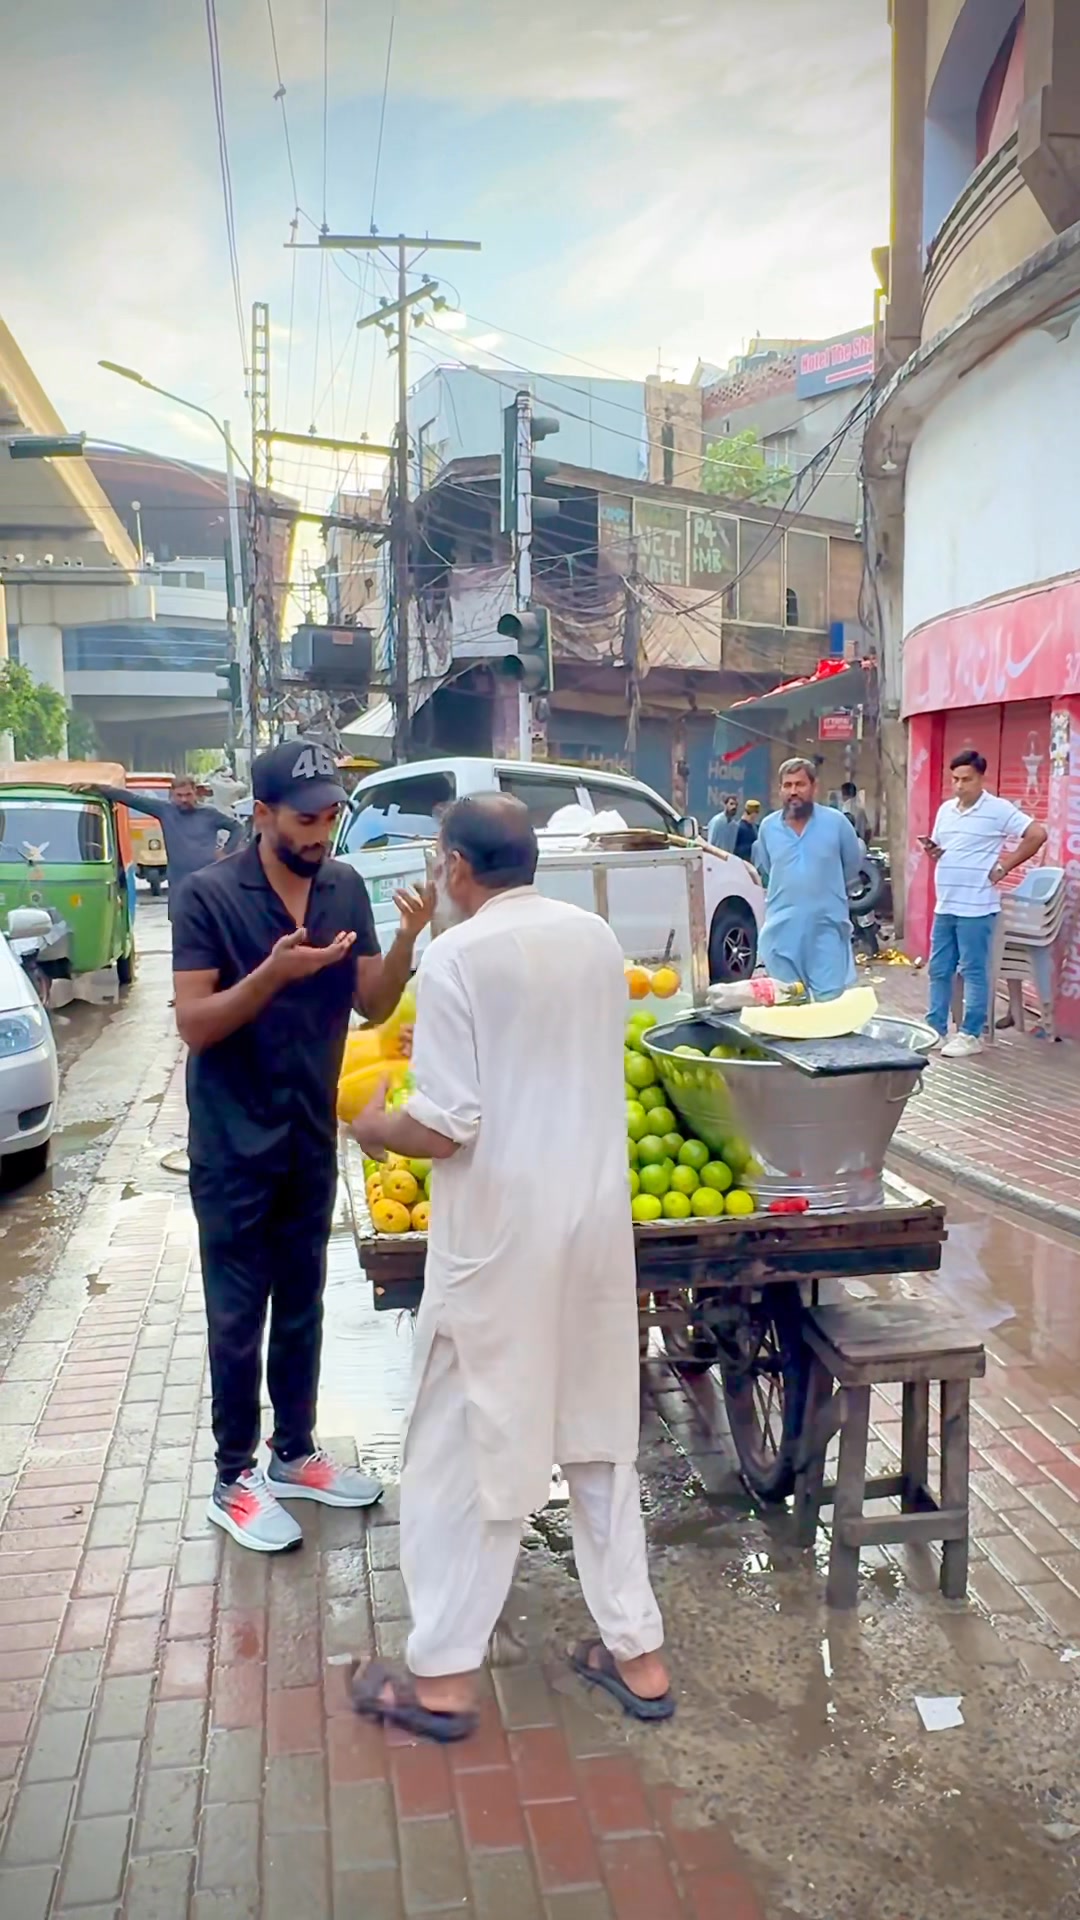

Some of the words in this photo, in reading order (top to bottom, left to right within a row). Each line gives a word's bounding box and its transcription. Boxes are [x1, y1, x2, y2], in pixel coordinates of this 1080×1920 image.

[801, 347, 830, 375] Hotel
[831, 343, 852, 366] The
[637, 525, 681, 559] NET
[292, 749, 334, 779] 46
